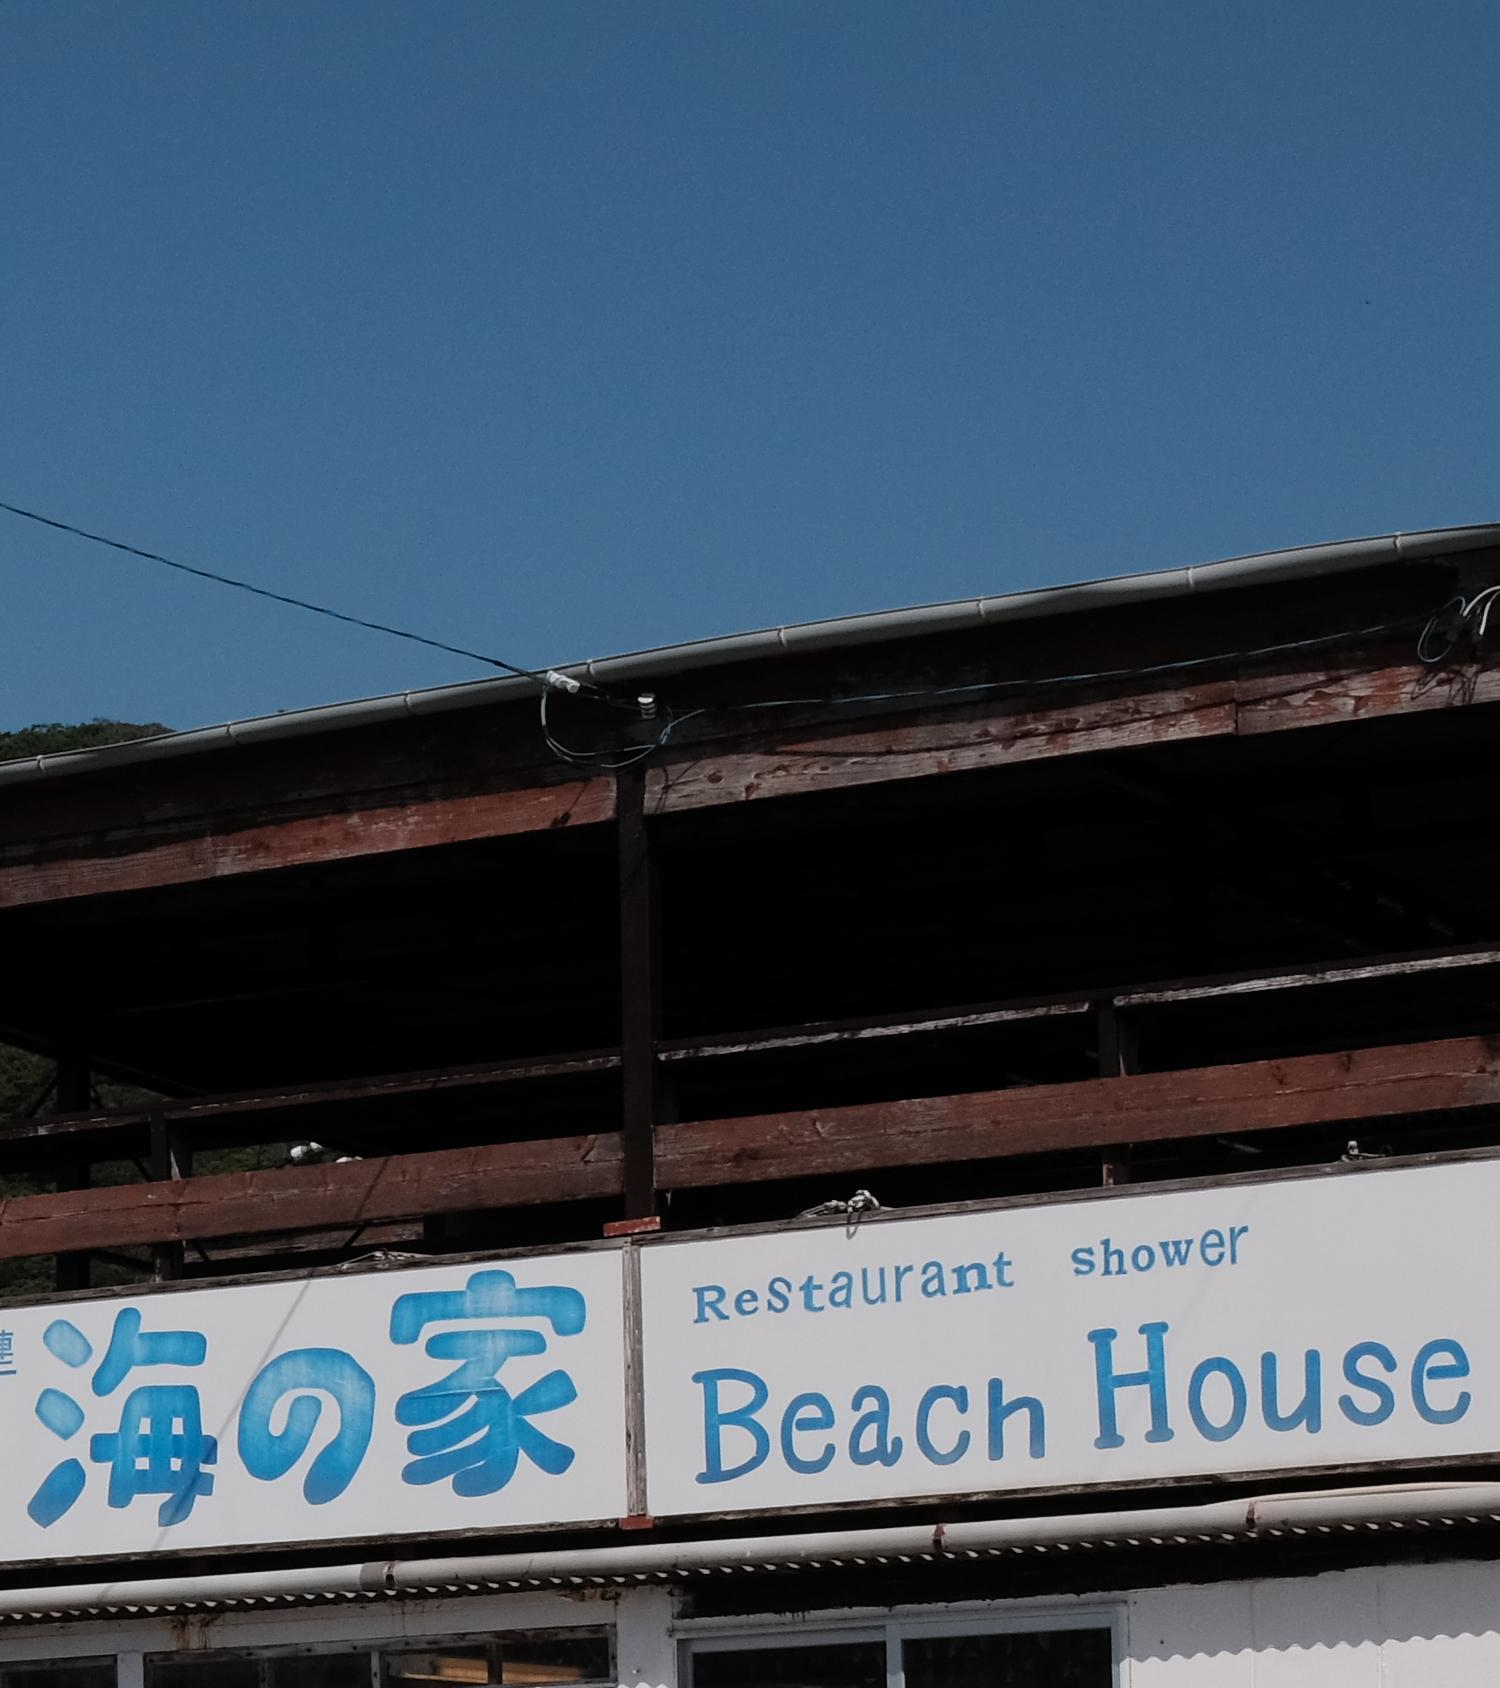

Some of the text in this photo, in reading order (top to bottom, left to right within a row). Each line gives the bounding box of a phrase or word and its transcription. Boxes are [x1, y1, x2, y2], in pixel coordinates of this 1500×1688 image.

[1069, 1223, 1249, 1281] shower
[26, 1267, 588, 1529] 海の家
[690, 1320, 1473, 1486] Beach House
